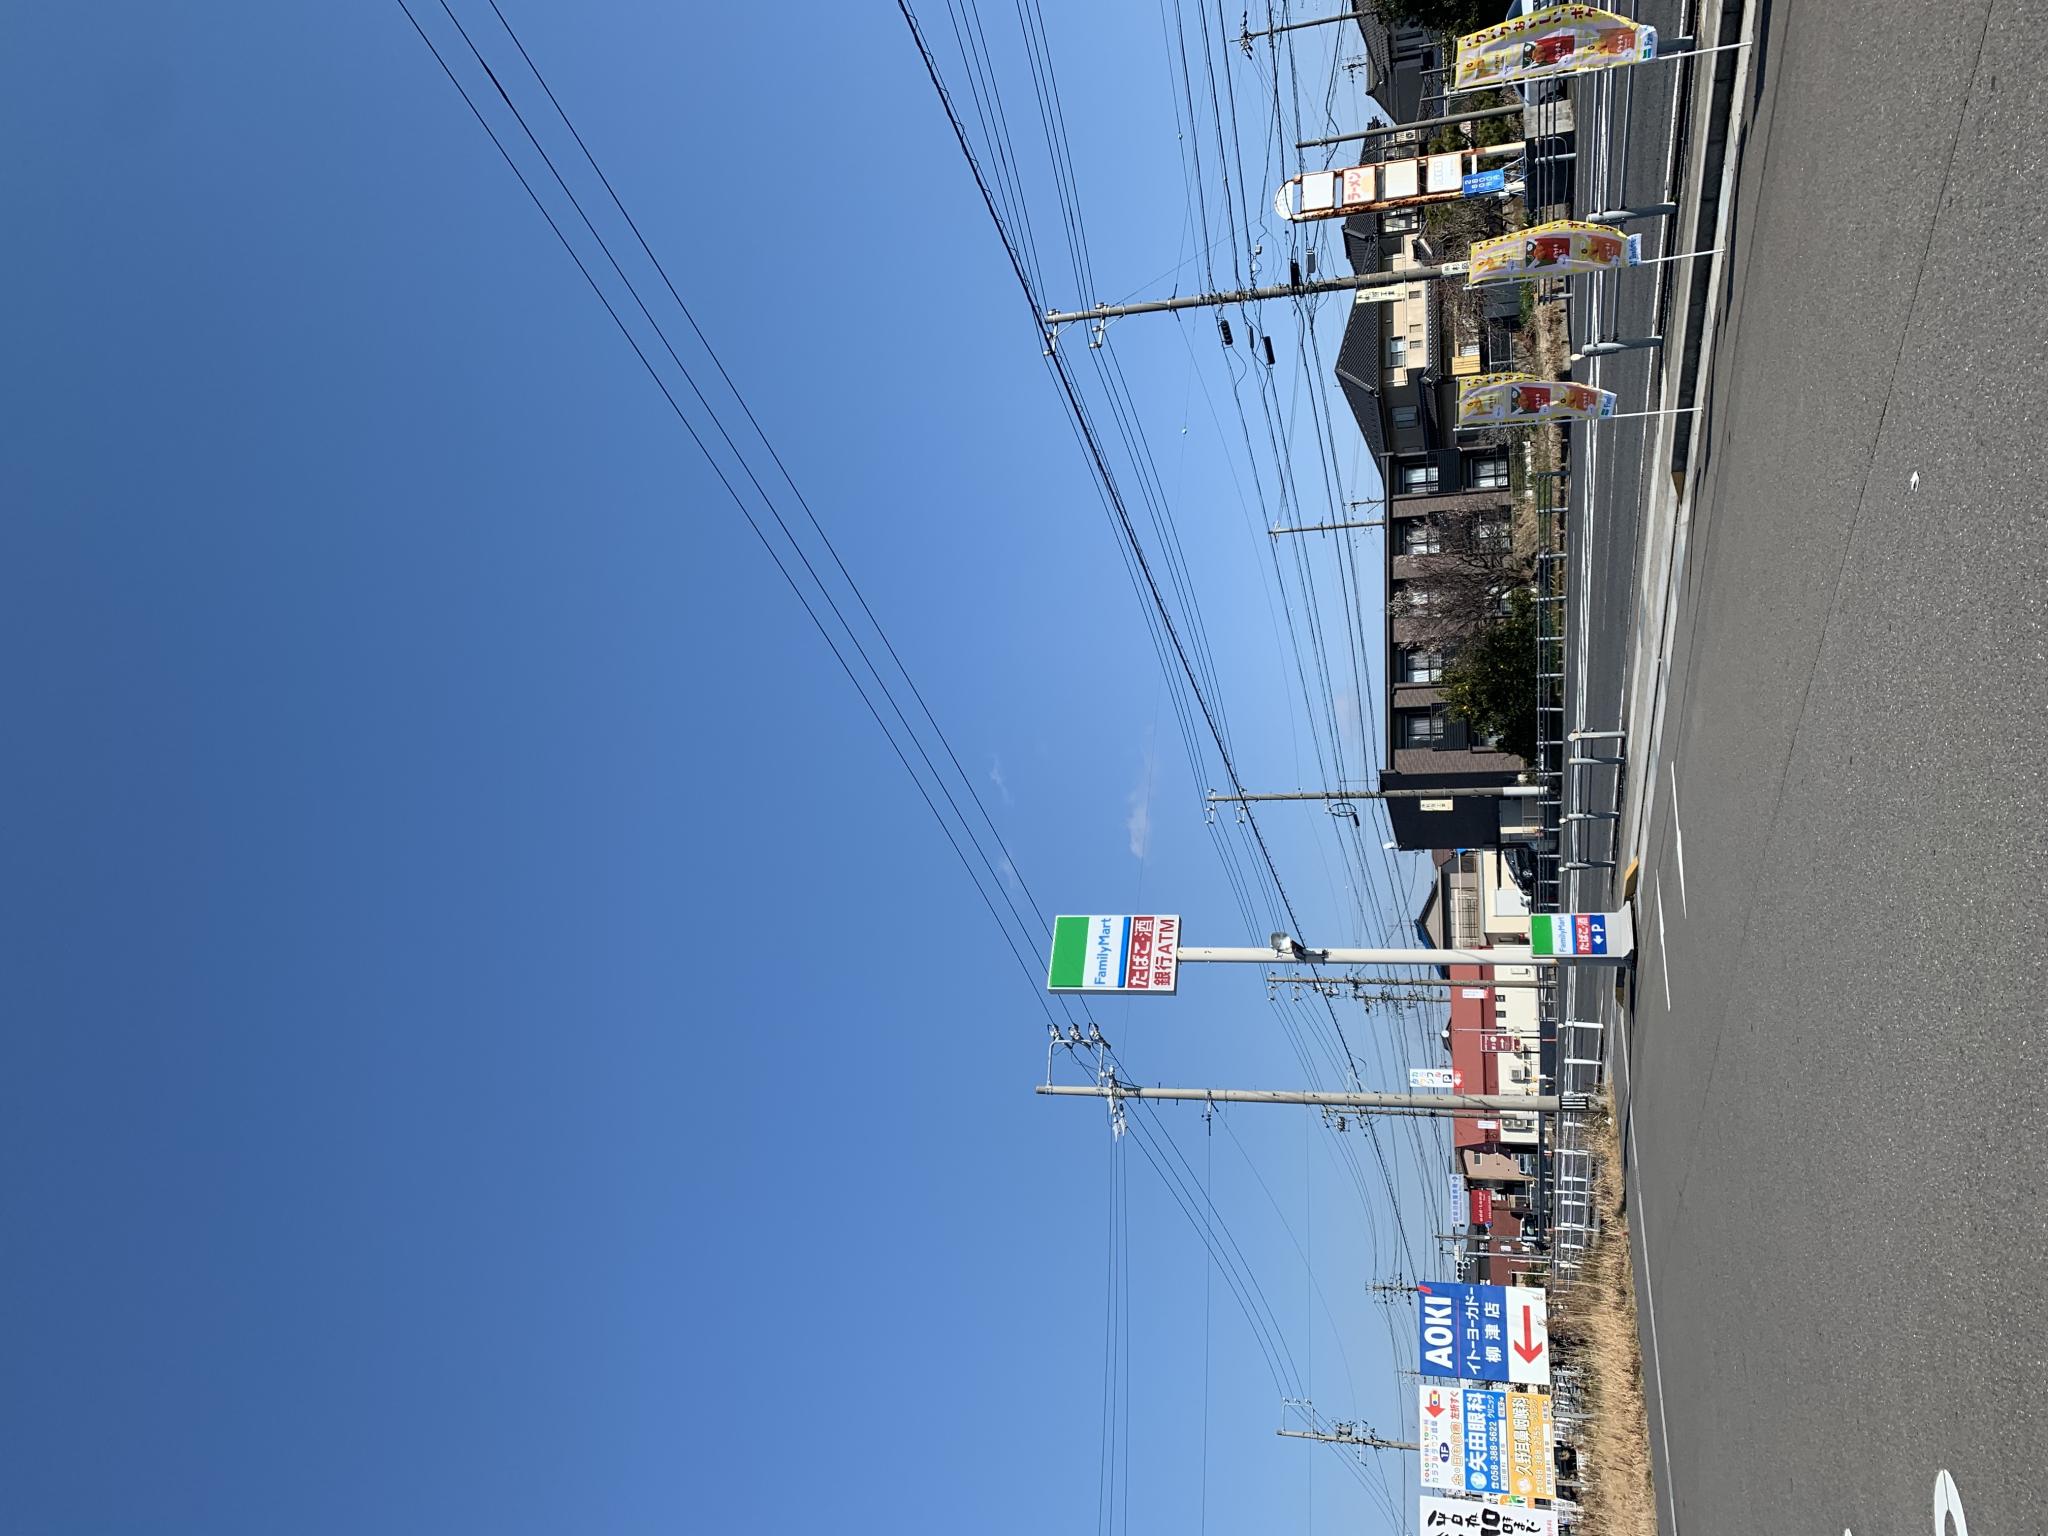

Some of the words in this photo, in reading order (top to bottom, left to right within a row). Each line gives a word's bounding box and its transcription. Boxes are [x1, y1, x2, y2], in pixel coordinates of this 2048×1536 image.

[1348, 172, 1360, 200] ラーメン
[1094, 918, 1112, 984] FamilyMart
[1131, 919, 1153, 986] たばこ・酒
[1154, 919, 1175, 986] 銀行ATM
[1558, 917, 1567, 952] FamilyMart
[1592, 924, 1604, 932] P
[1424, 1296, 1453, 1368] AOKI
[1465, 1287, 1481, 1375] イトーヨーカドー
[1484, 1302, 1502, 1363] 柳津店
[1450, 1392, 1460, 1419] 左折すぐ
[1466, 1393, 1488, 1472] 矢田眼科
[1440, 1446, 1449, 1458] 1F
[1489, 1422, 1499, 1481] 058-388-5622
